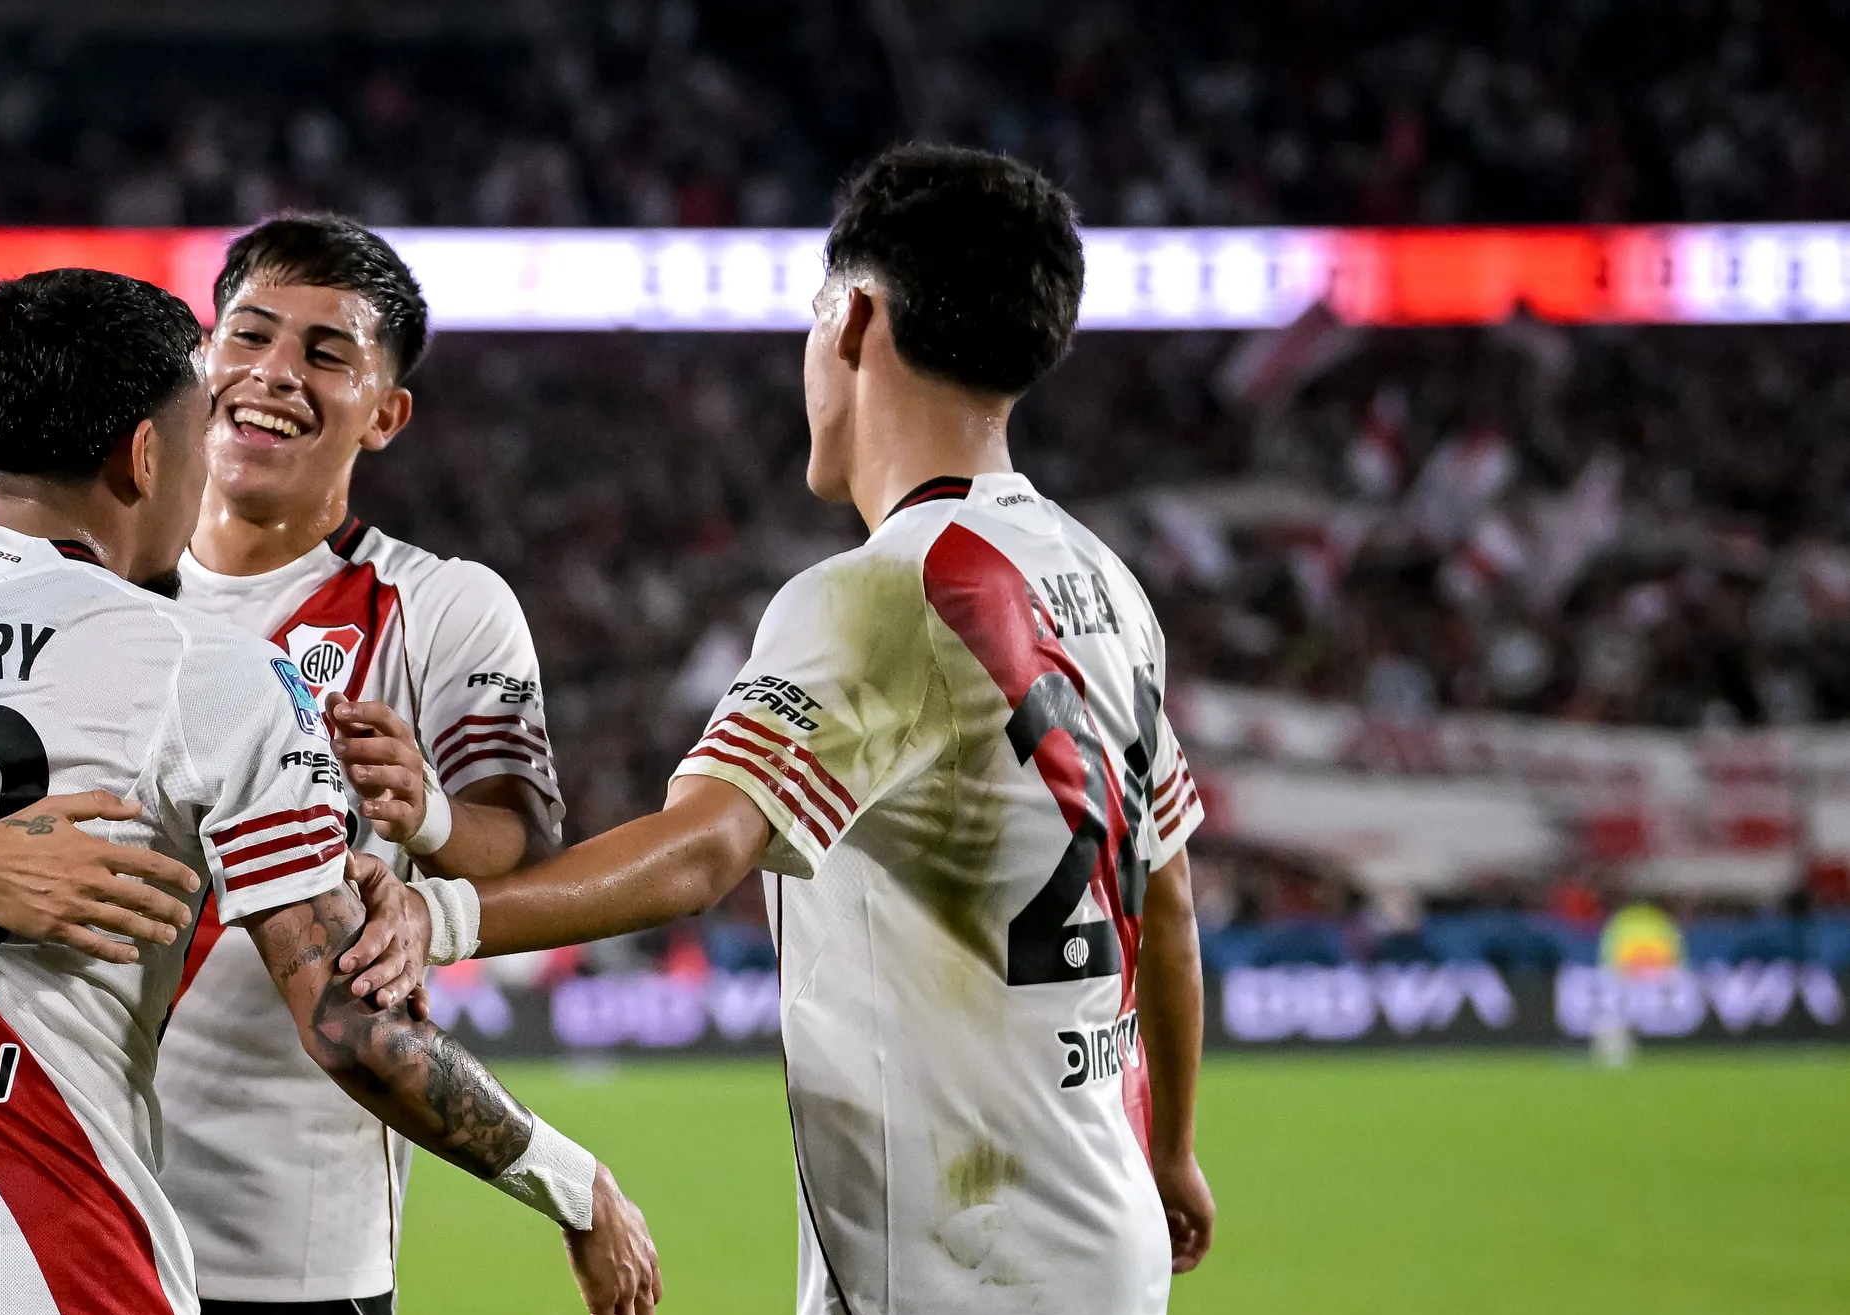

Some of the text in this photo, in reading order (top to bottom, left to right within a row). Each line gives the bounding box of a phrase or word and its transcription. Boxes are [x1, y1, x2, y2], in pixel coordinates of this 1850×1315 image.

[1041, 571, 1120, 638] MEA
[467, 672, 538, 692] ASSIS
[727, 675, 824, 711] ASIST
[742, 689, 820, 731] CARD
